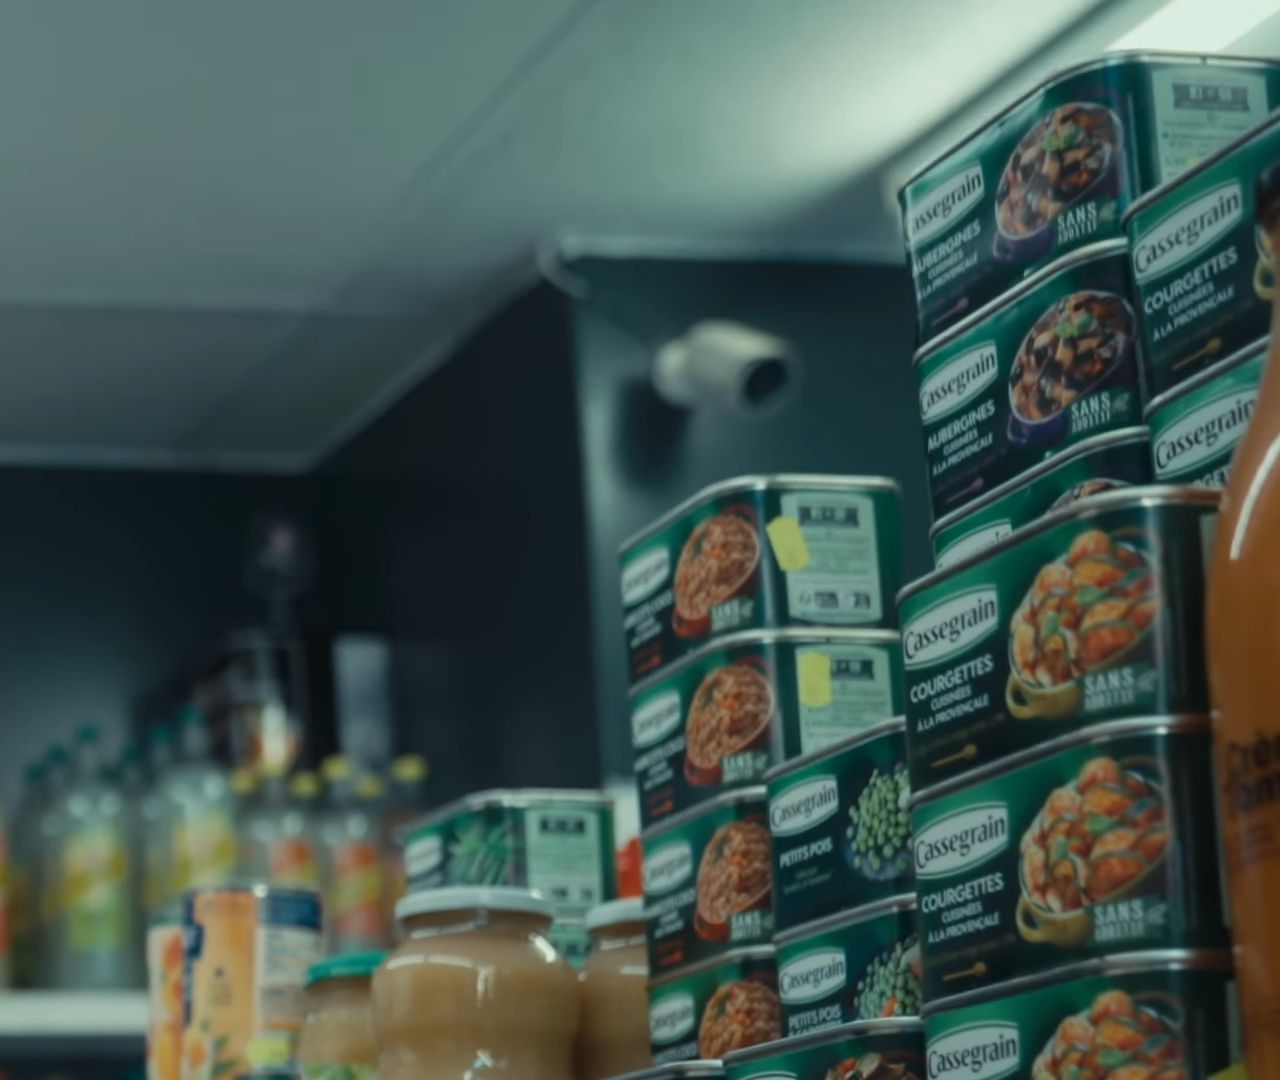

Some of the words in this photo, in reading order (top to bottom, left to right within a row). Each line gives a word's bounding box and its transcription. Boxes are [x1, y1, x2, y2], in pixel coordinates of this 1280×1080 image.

[912, 172, 981, 233] assegrain
[1057, 201, 1098, 230] SANS
[1136, 192, 1239, 274] Cassegrain
[1144, 246, 1238, 314] COURGETTES
[922, 353, 996, 416] Cassegrain
[1071, 392, 1111, 418] SANS
[928, 399, 996, 452] AUBERGINES
[905, 598, 995, 660] Cassegrain
[910, 653, 994, 703] COURGETTES
[1084, 667, 1134, 695] SANS
[916, 815, 1006, 869] Cassegrain
[922, 872, 1004, 913] COURGETTES
[1094, 900, 1143, 926] SANS
[928, 1035, 1017, 1080] Cassegrain
